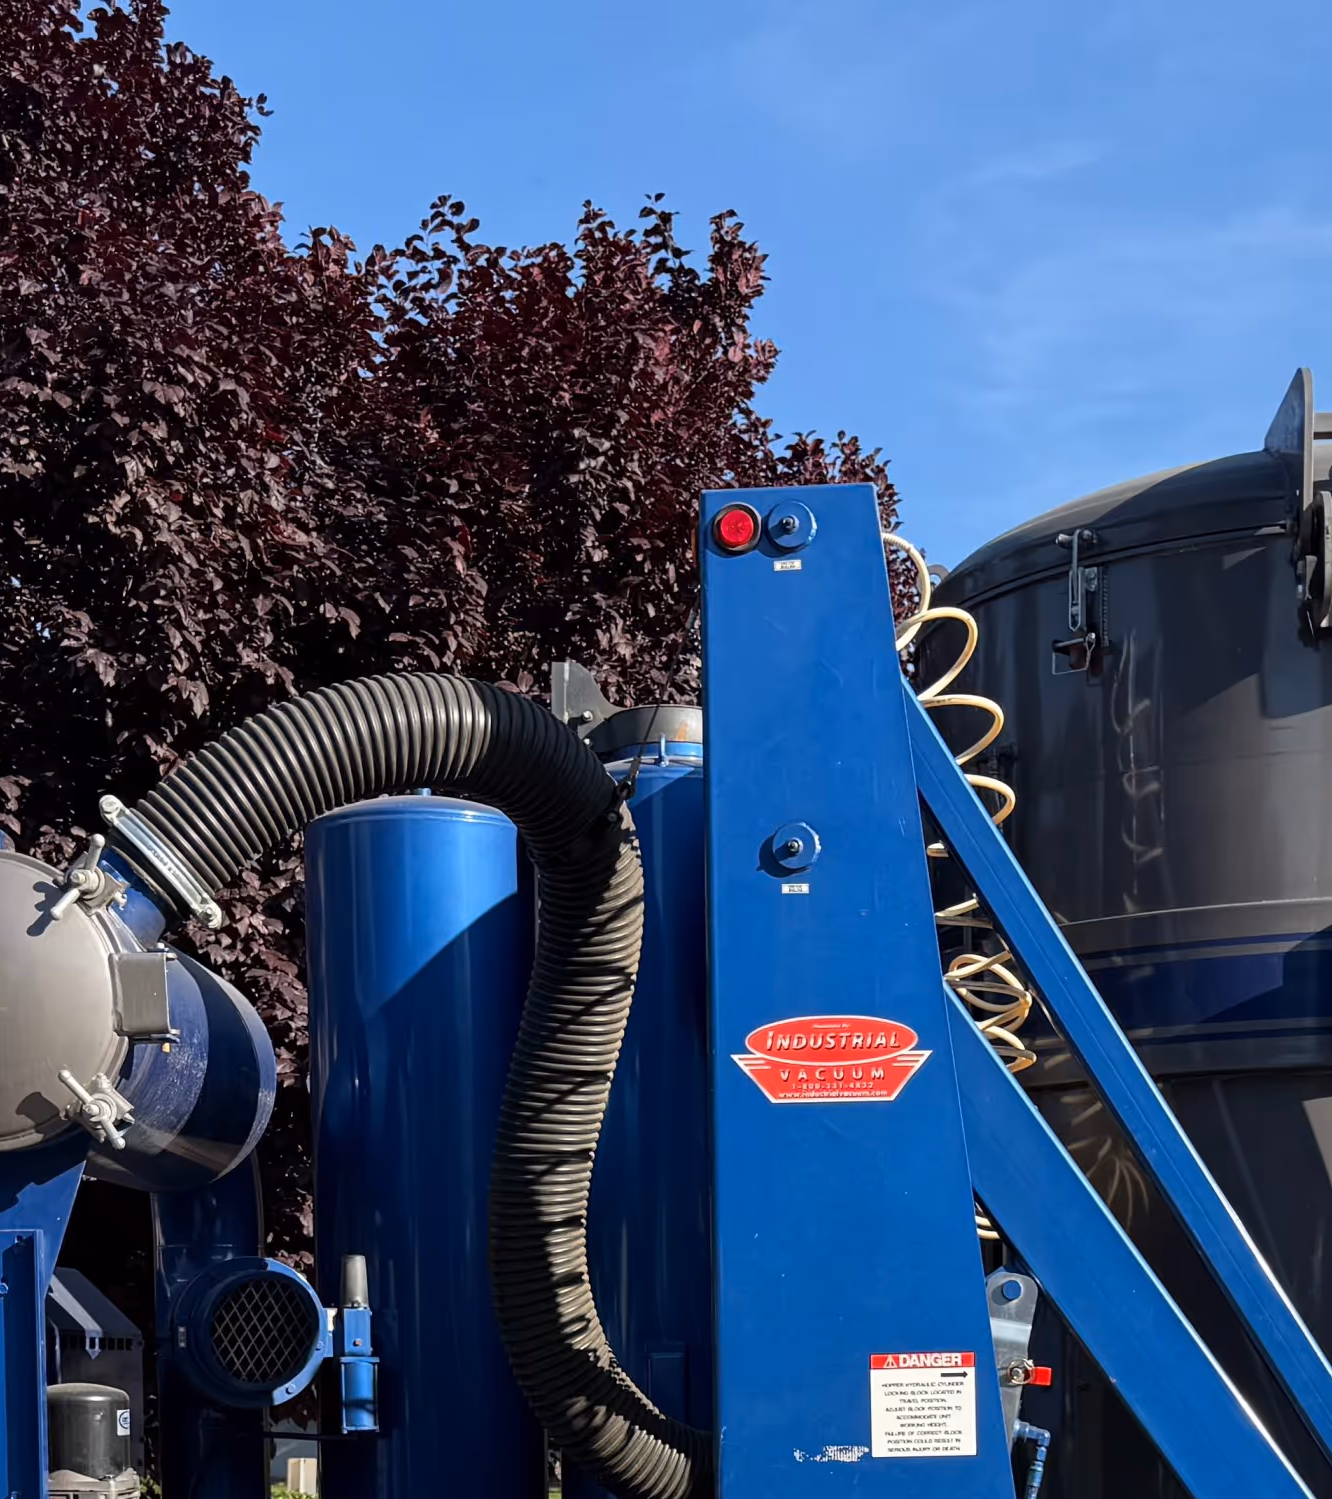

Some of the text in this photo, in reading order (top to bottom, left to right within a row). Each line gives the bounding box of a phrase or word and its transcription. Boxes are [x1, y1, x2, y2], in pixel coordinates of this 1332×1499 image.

[766, 1031, 901, 1050] INDUSTRIAL
[780, 1067, 885, 1082] VACUUM
[899, 1353, 962, 1367] DANGER
